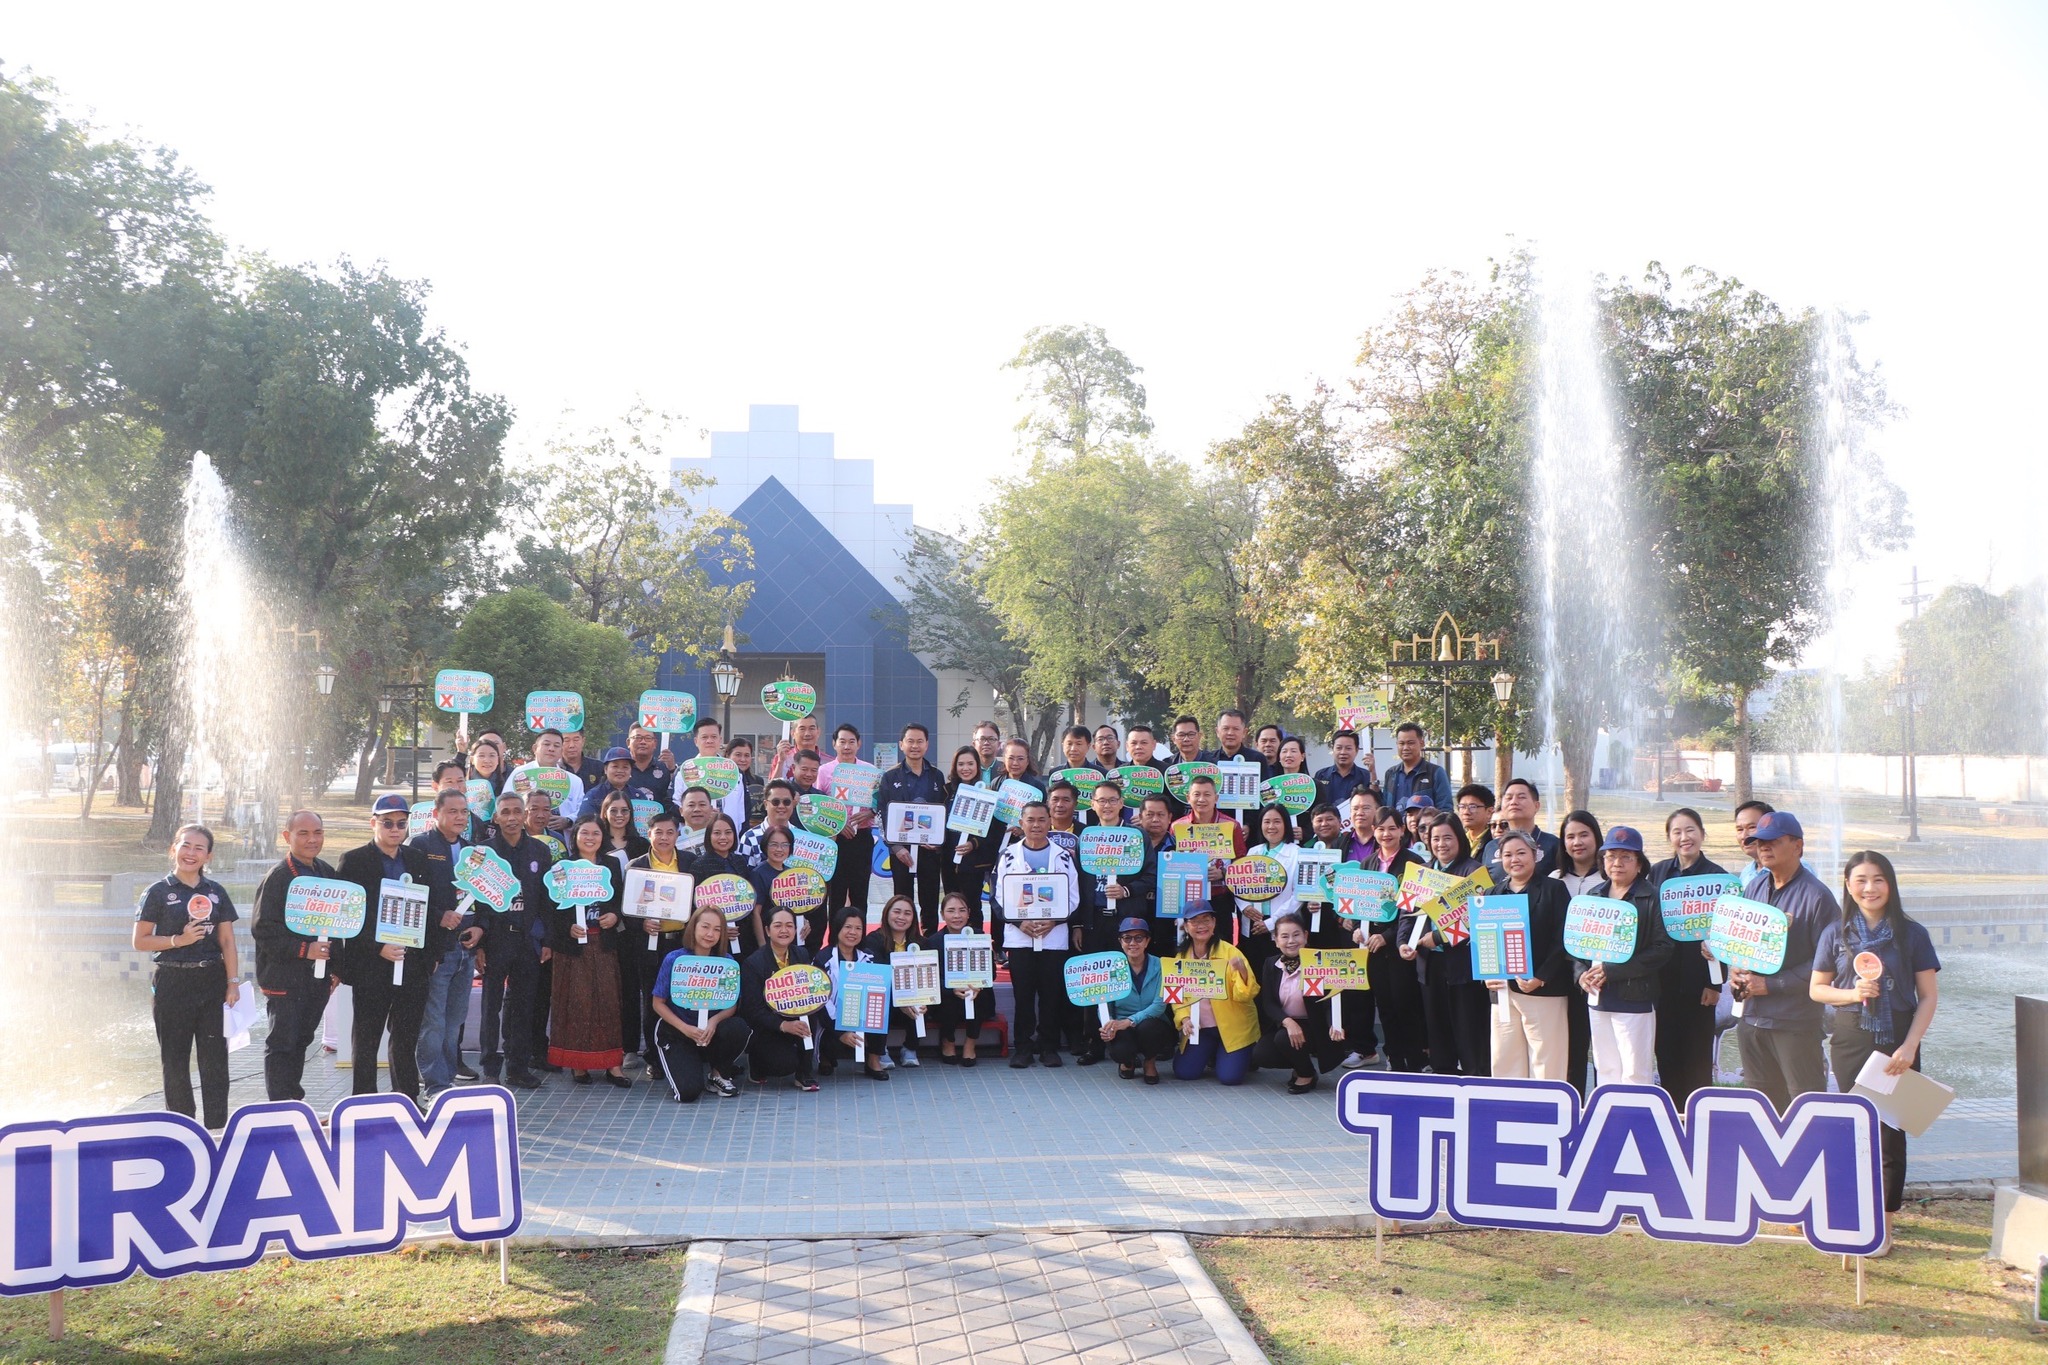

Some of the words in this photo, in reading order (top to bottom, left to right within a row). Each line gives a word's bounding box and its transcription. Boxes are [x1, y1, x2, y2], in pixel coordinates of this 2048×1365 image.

[1345, 695, 1352, 706] 1
[549, 791, 566, 801] บจ.
[1082, 832, 1108, 844] เลือกตั้ง
[1108, 834, 1130, 842] อบจ.
[1187, 826, 1194, 838] 1
[1227, 860, 1252, 875] คนดี
[774, 874, 797, 890] คนดี
[1226, 874, 1266, 887] คนสุจริต
[1418, 868, 1425, 882] 1
[289, 884, 322, 896] เลือกตั้ง
[324, 886, 350, 900] อบจ.
[469, 876, 504, 908] เลือกตั้ง
[568, 886, 608, 898] เลือกตั้ง
[696, 880, 722, 896] คนดี
[1233, 884, 1281, 896] ไม่ขายเสียง
[1662, 884, 1694, 901] เลือกตั้ง
[1696, 883, 1726, 896] อบจ.
[1438, 896, 1452, 910] 1
[1568, 904, 1598, 918] เลือกตั้ง
[1598, 908, 1622, 921] อบจ.
[1715, 904, 1744, 921] เลือกตั้ง
[1746, 911, 1770, 928] อบจ.
[1314, 950, 1322, 965] 1
[673, 962, 702, 973] เลือกตั้ง
[702, 963, 726, 975] อบจ.
[1065, 961, 1092, 975] เลือกตั้ง
[1092, 958, 1115, 970] อบจ.
[1174, 960, 1182, 974] 1
[1304, 966, 1338, 979] เข้าคูหา
[766, 972, 794, 990] คนดี
[1164, 974, 1198, 988] เข้าคูหา
[1358, 976, 1365, 984] ใบ
[766, 984, 810, 1002] คนสุจริต
[1216, 986, 1224, 994] ใบ
[774, 993, 828, 1012] ไม่ขายเสียง
[1358, 1093, 1860, 1232] TEAM
[15, 1109, 501, 1271] IRAM
